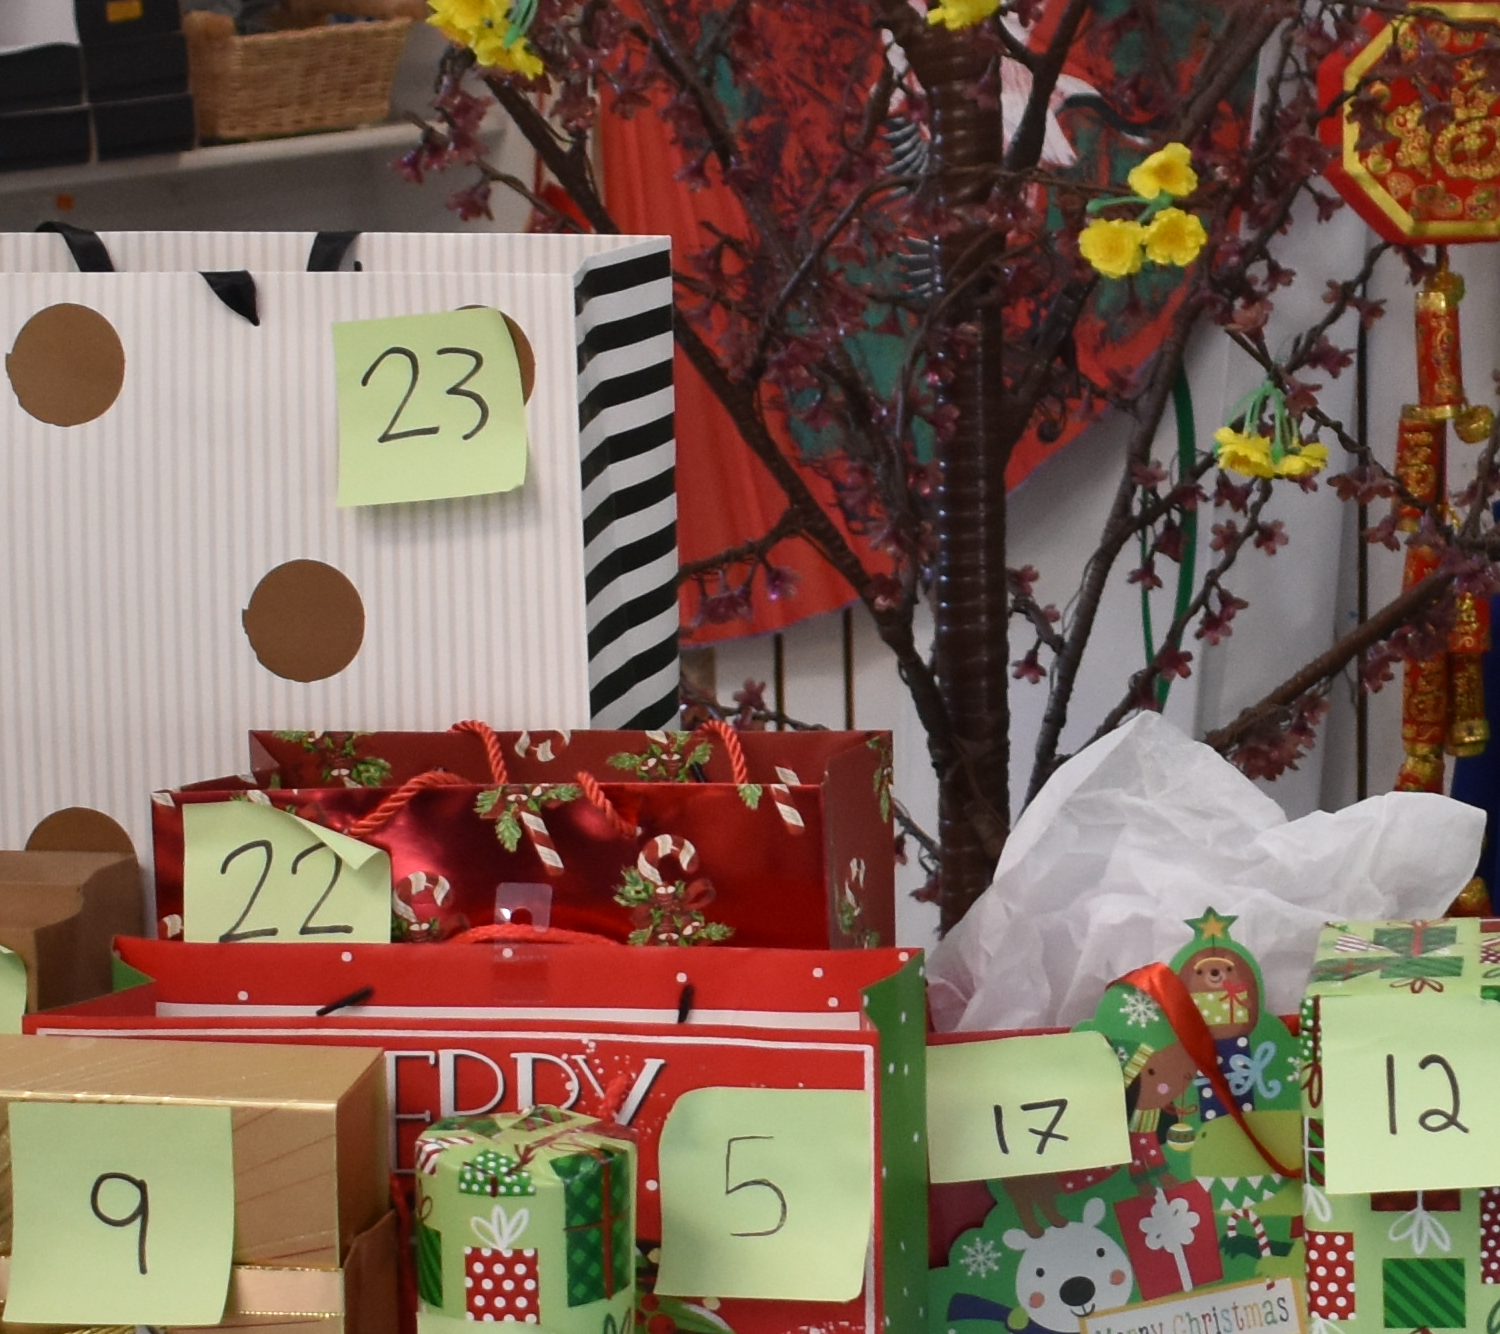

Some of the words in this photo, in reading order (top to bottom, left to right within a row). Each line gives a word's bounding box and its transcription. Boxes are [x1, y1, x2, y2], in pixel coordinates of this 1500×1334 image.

[360, 346, 490, 444] 23
[218, 840, 354, 943] 22
[993, 1098, 1070, 1156] 17
[1385, 1053, 1470, 1136] 12
[90, 1171, 150, 1275] 9
[725, 1135, 787, 1238] 5
